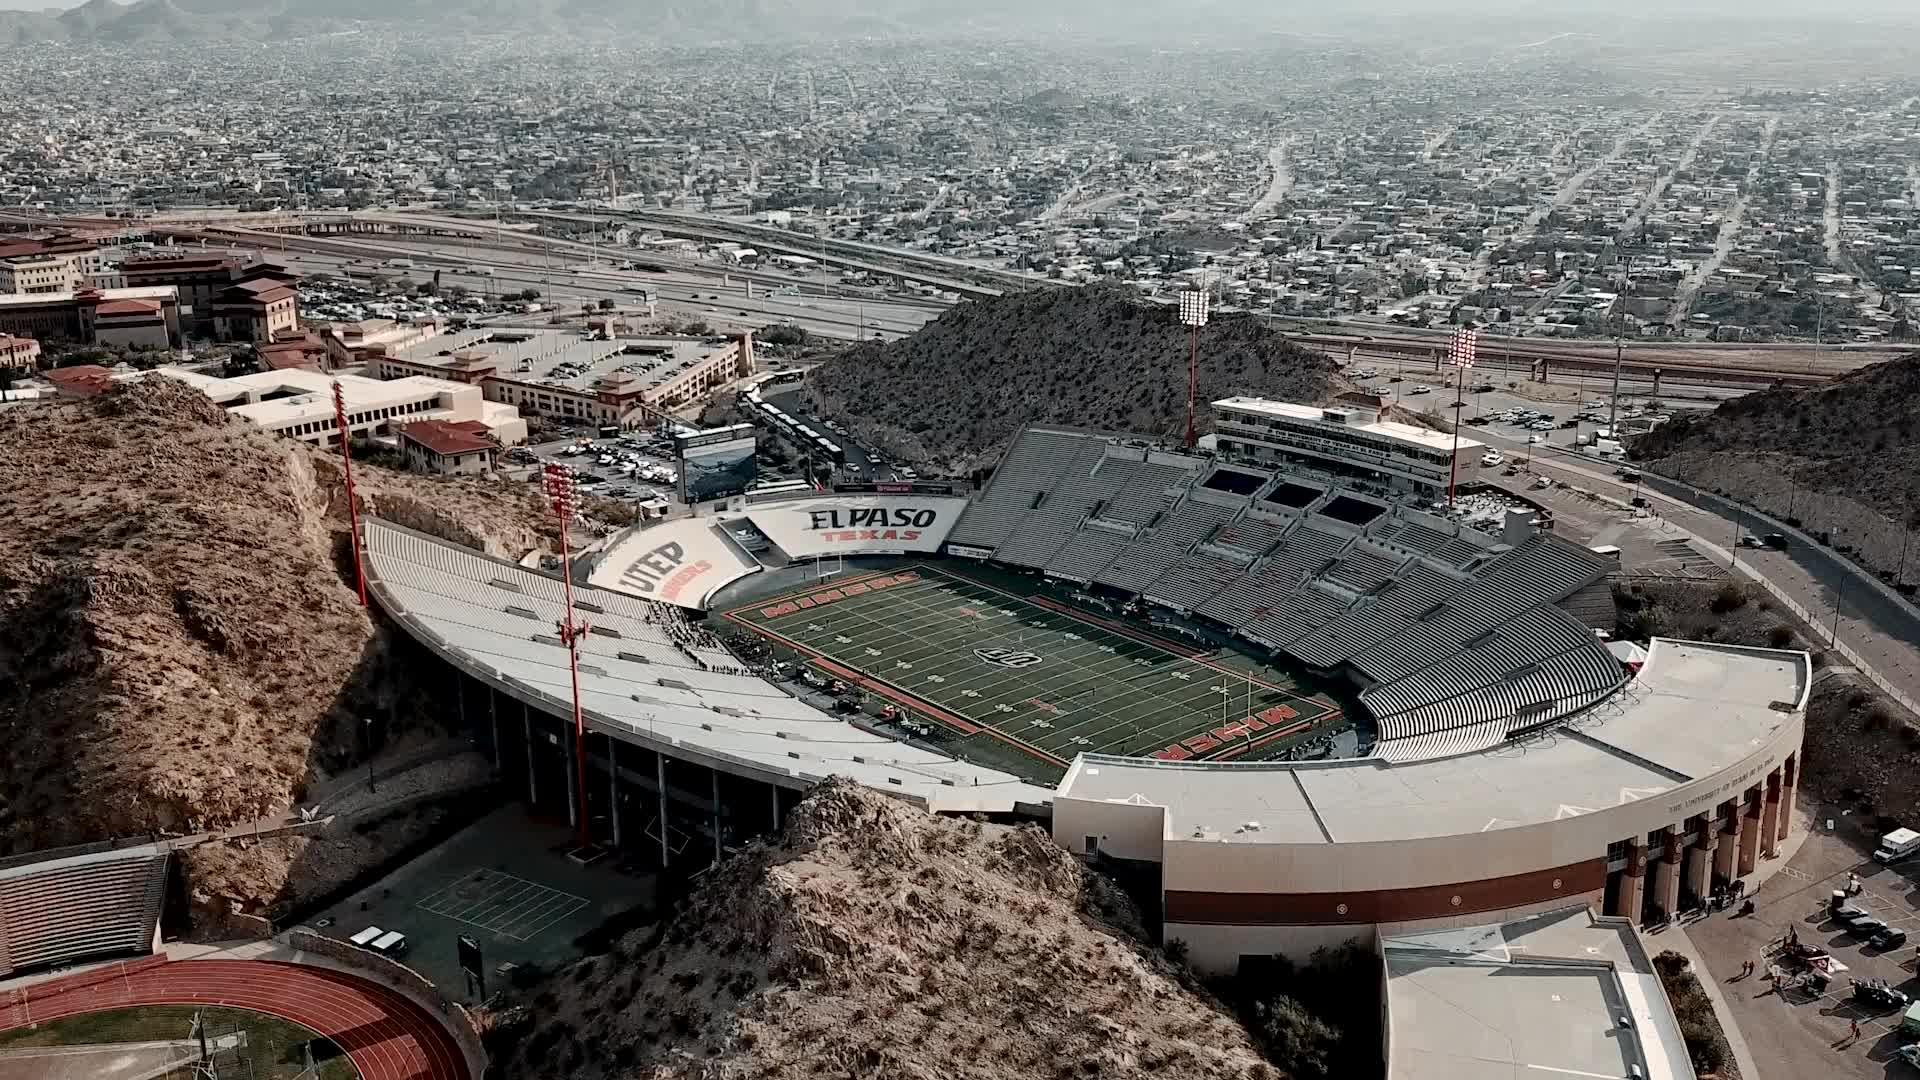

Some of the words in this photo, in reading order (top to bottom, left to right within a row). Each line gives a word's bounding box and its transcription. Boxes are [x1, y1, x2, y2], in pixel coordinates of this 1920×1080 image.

[1332, 441, 1351, 449] TEXAS
[809, 510, 844, 529] EL
[849, 508, 936, 528] PASO
[821, 530, 921, 542] TEXAS
[619, 541, 684, 592] UTEP
[760, 571, 921, 619] MINERS
[1149, 703, 1300, 761] MINER
